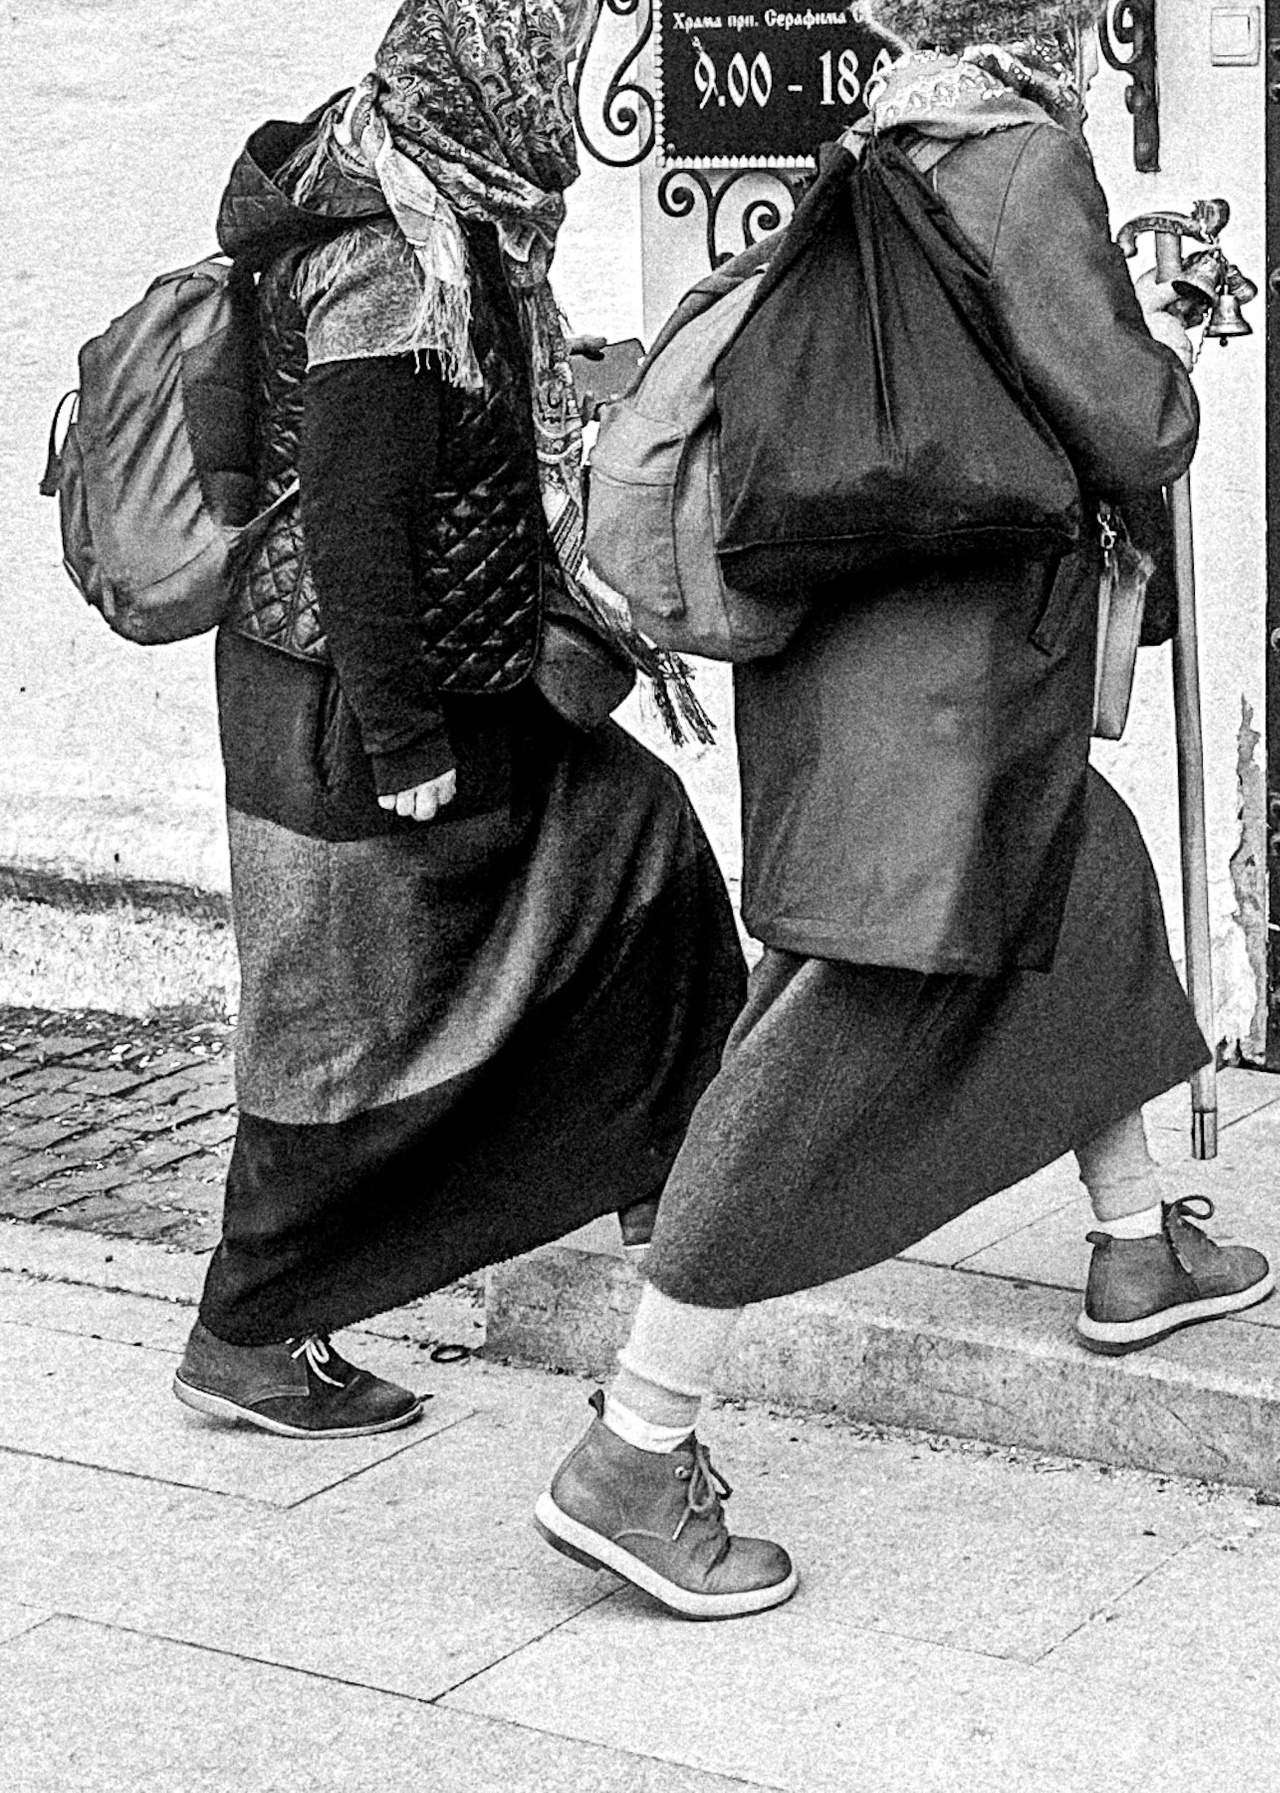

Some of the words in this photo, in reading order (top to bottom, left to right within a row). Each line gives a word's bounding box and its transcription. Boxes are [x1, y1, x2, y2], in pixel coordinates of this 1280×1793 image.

[673, 12, 722, 33] Храма
[727, 14, 759, 32] прп.
[764, 8, 847, 31] Серафима
[692, 50, 772, 109] 9.00
